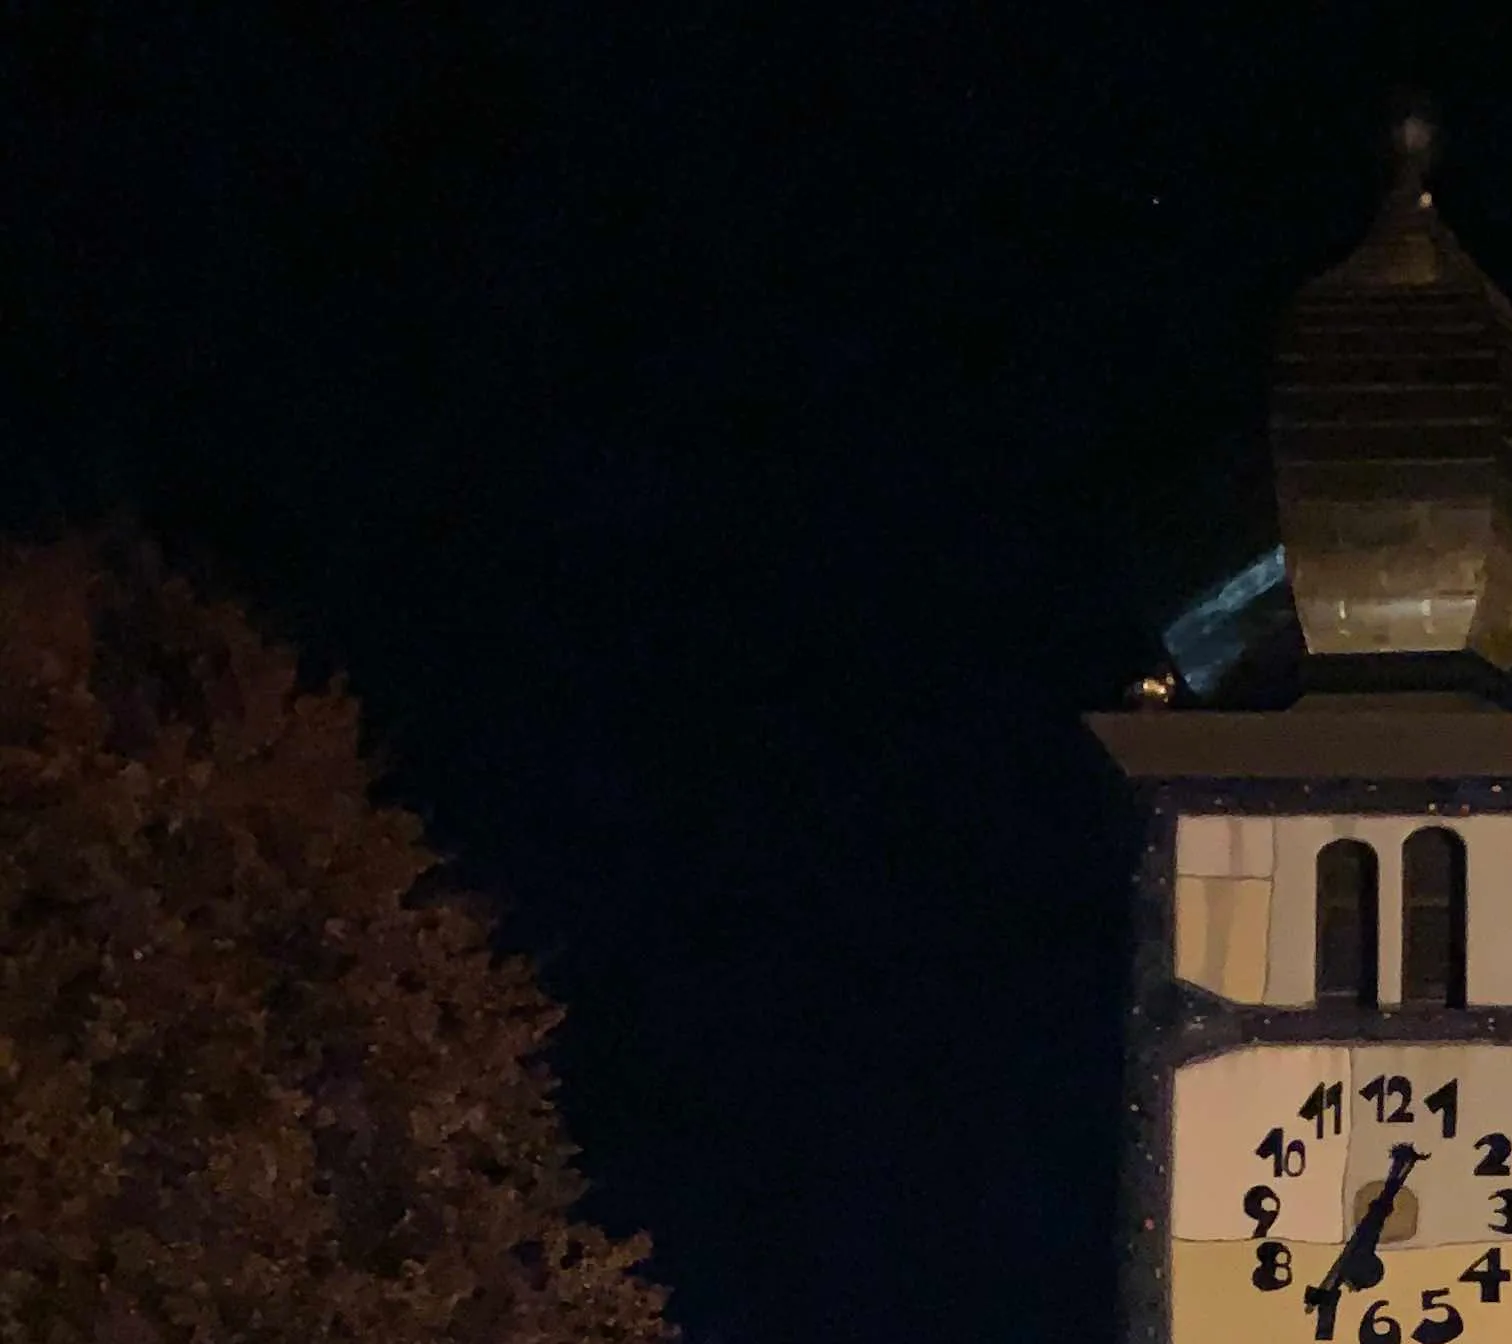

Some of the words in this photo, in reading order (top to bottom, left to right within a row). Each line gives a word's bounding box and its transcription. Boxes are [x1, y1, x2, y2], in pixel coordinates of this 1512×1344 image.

[1299, 1081, 1343, 1139] 11
[1359, 1075, 1414, 1122] 12
[1424, 1078, 1458, 1138] 1
[1256, 1127, 1306, 1177] 10
[1473, 1133, 1512, 1176] 2
[1243, 1185, 1280, 1239] 9
[1252, 1242, 1293, 1291] 8
[1458, 1248, 1511, 1302] 4
[1411, 1287, 1464, 1344] 5
